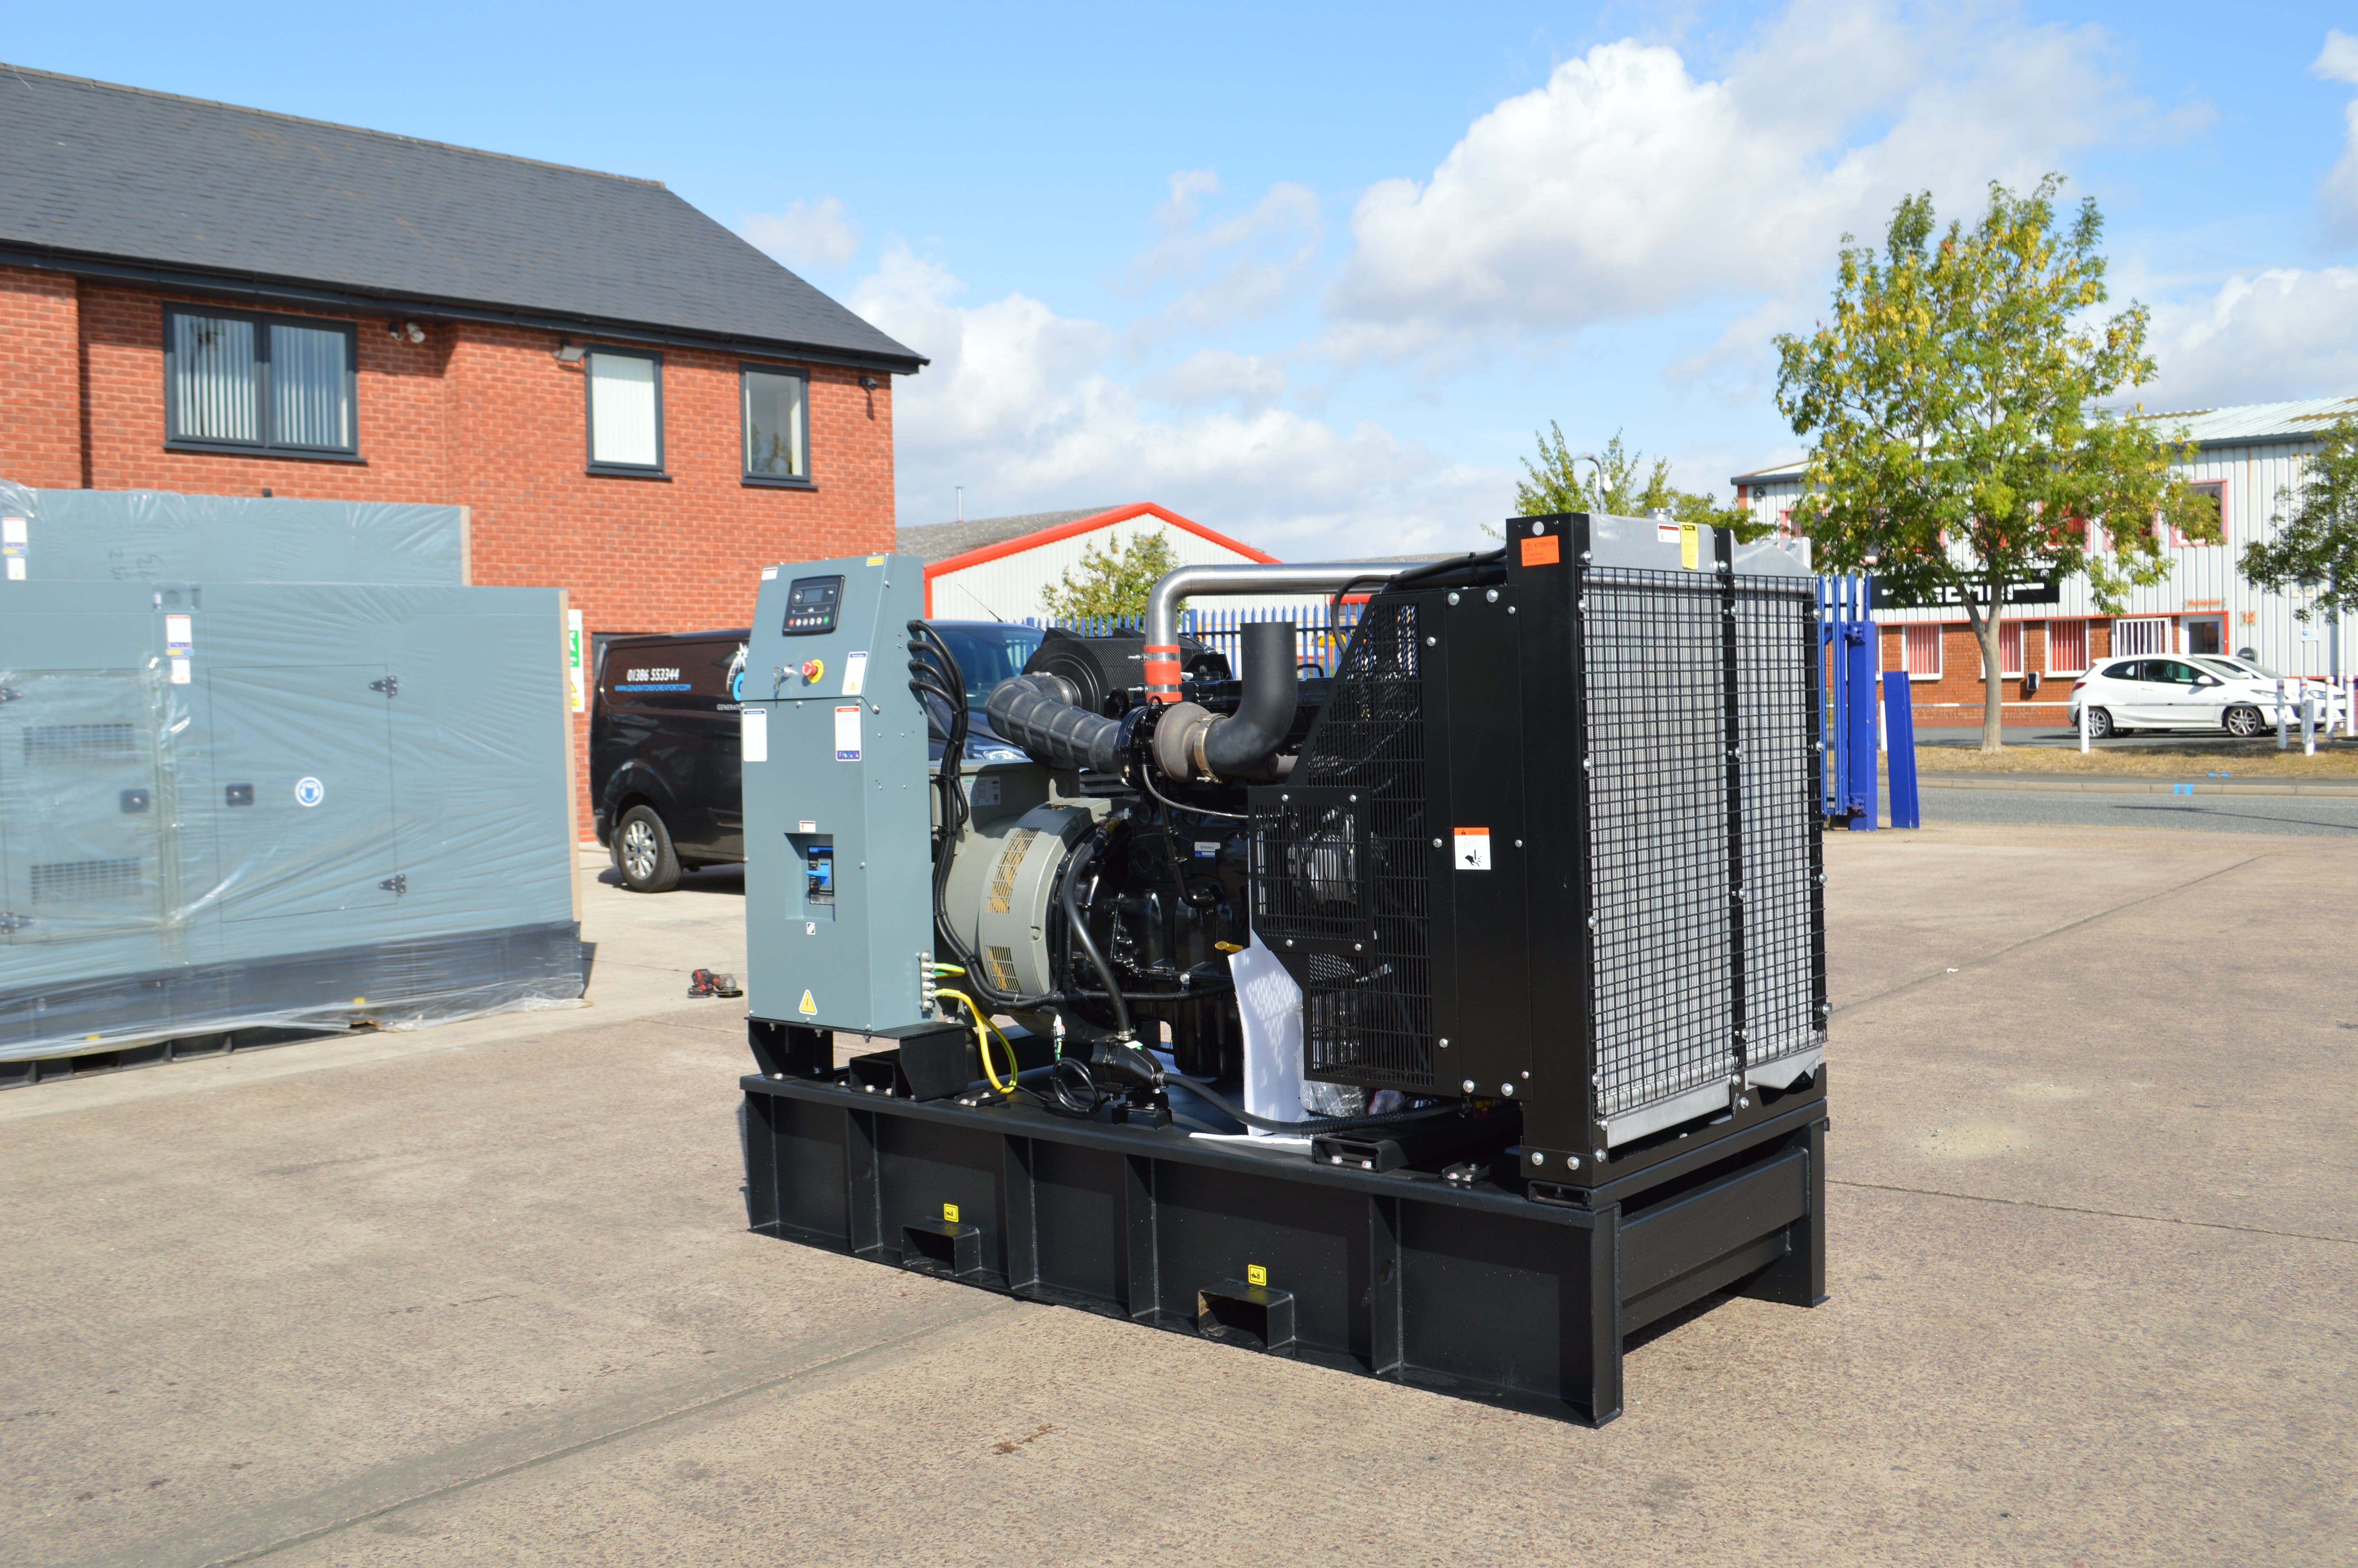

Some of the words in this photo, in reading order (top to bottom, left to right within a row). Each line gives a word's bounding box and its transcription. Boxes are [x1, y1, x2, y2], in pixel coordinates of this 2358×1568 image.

[2243, 612, 2254, 623] 12
[626, 669, 650, 682] 01386
[650, 668, 680, 681] 553344
